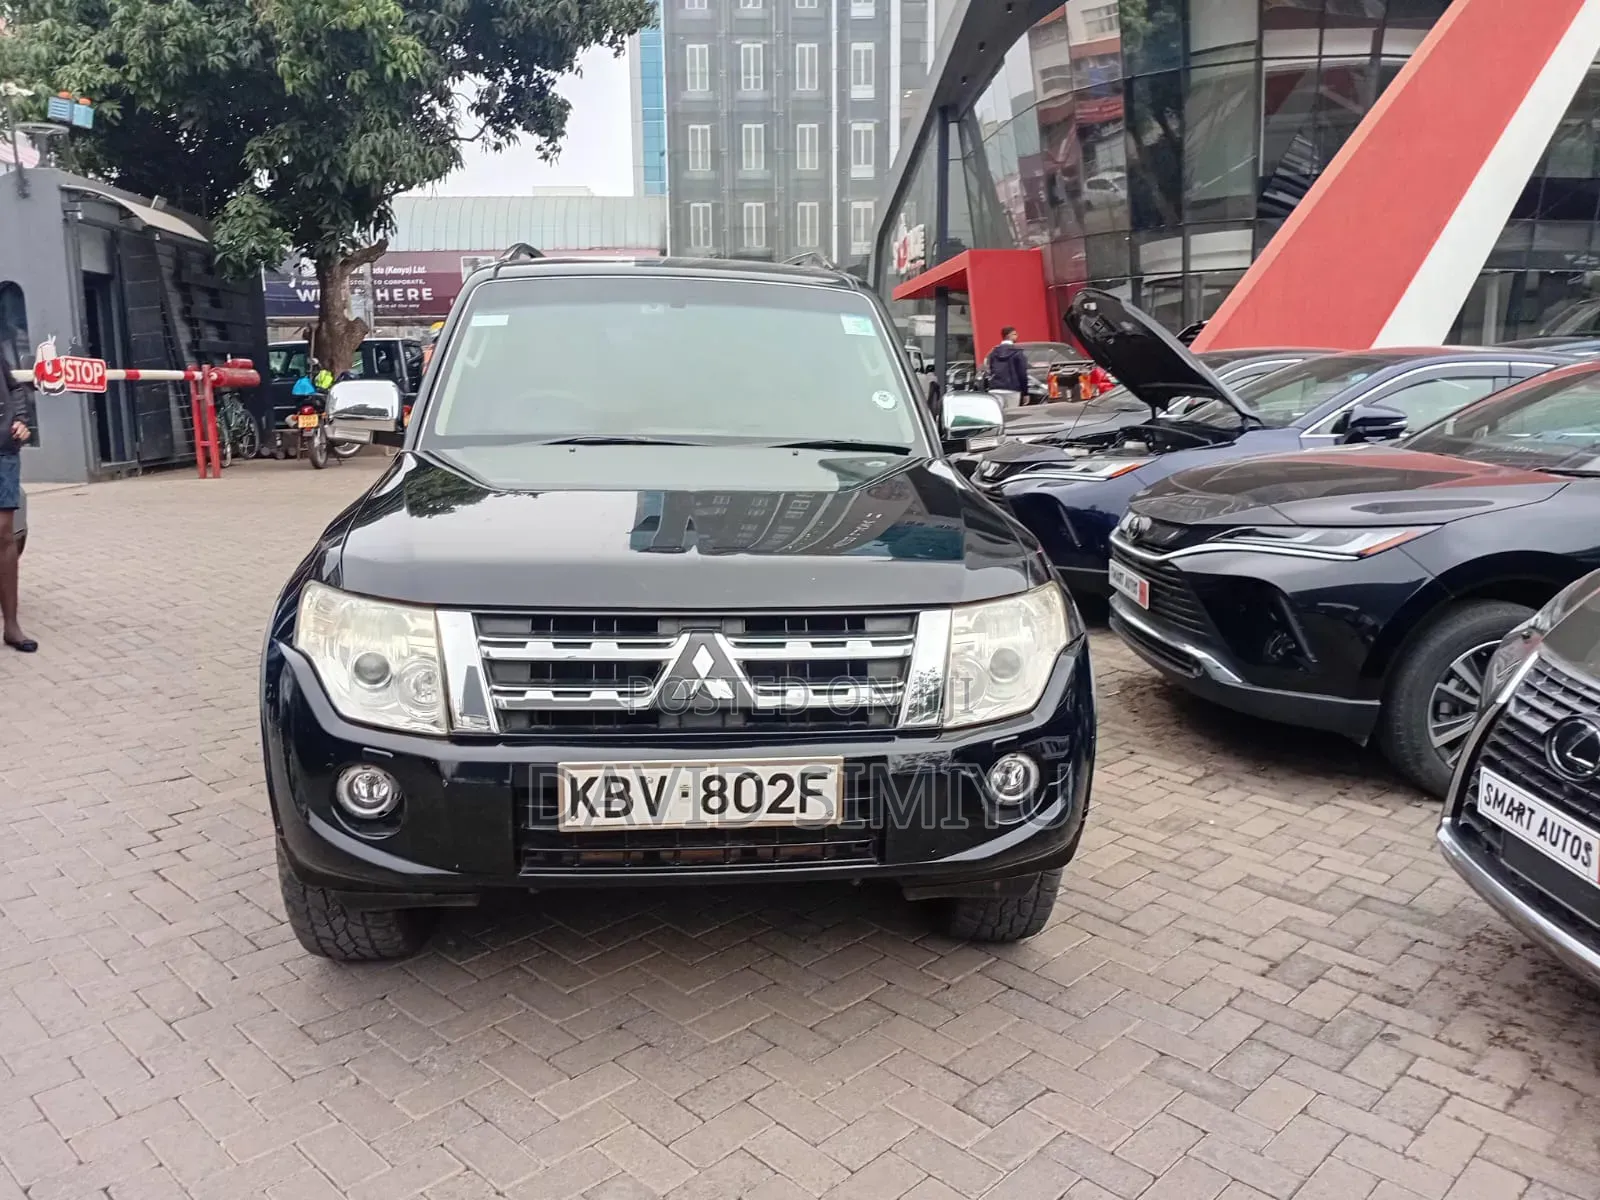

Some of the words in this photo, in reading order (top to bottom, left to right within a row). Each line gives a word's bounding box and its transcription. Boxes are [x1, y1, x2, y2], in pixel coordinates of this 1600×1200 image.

[376, 287, 434, 301] HERE
[65, 359, 104, 384] STOP
[570, 775, 668, 819] KBV
[700, 772, 828, 816] 802F
[1484, 783, 1535, 831] SMART
[1537, 816, 1593, 867] AUTOS
